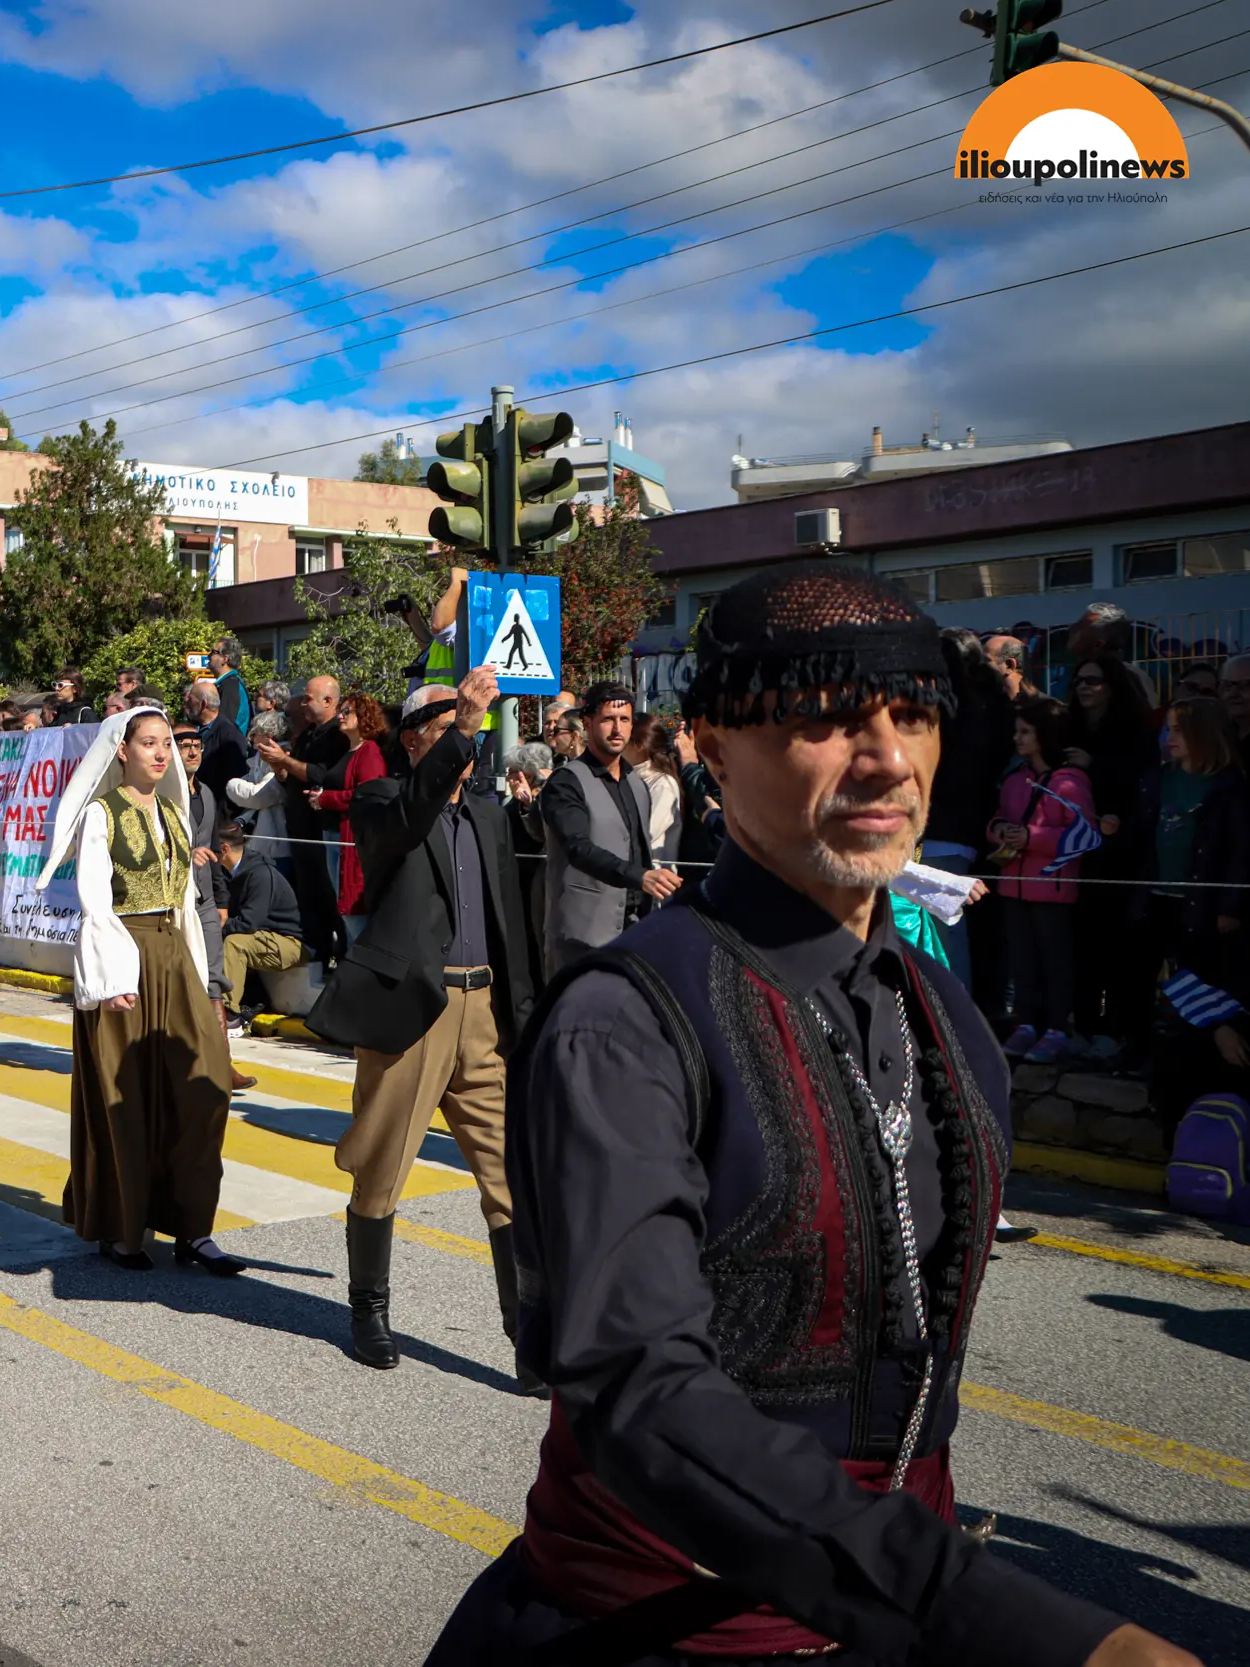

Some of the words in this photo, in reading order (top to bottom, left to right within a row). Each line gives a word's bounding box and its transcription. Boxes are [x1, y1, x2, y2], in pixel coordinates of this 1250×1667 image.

[230, 480, 297, 498] ΣΧΟΛΕΙΟ
[165, 497, 239, 511] ΛΙΟΥΠΟΛΗΣ
[23, 756, 82, 798] ΝΟΙΚ
[2, 803, 49, 841] ΜΑΣ
[11, 894, 76, 919] Συνέλευση
